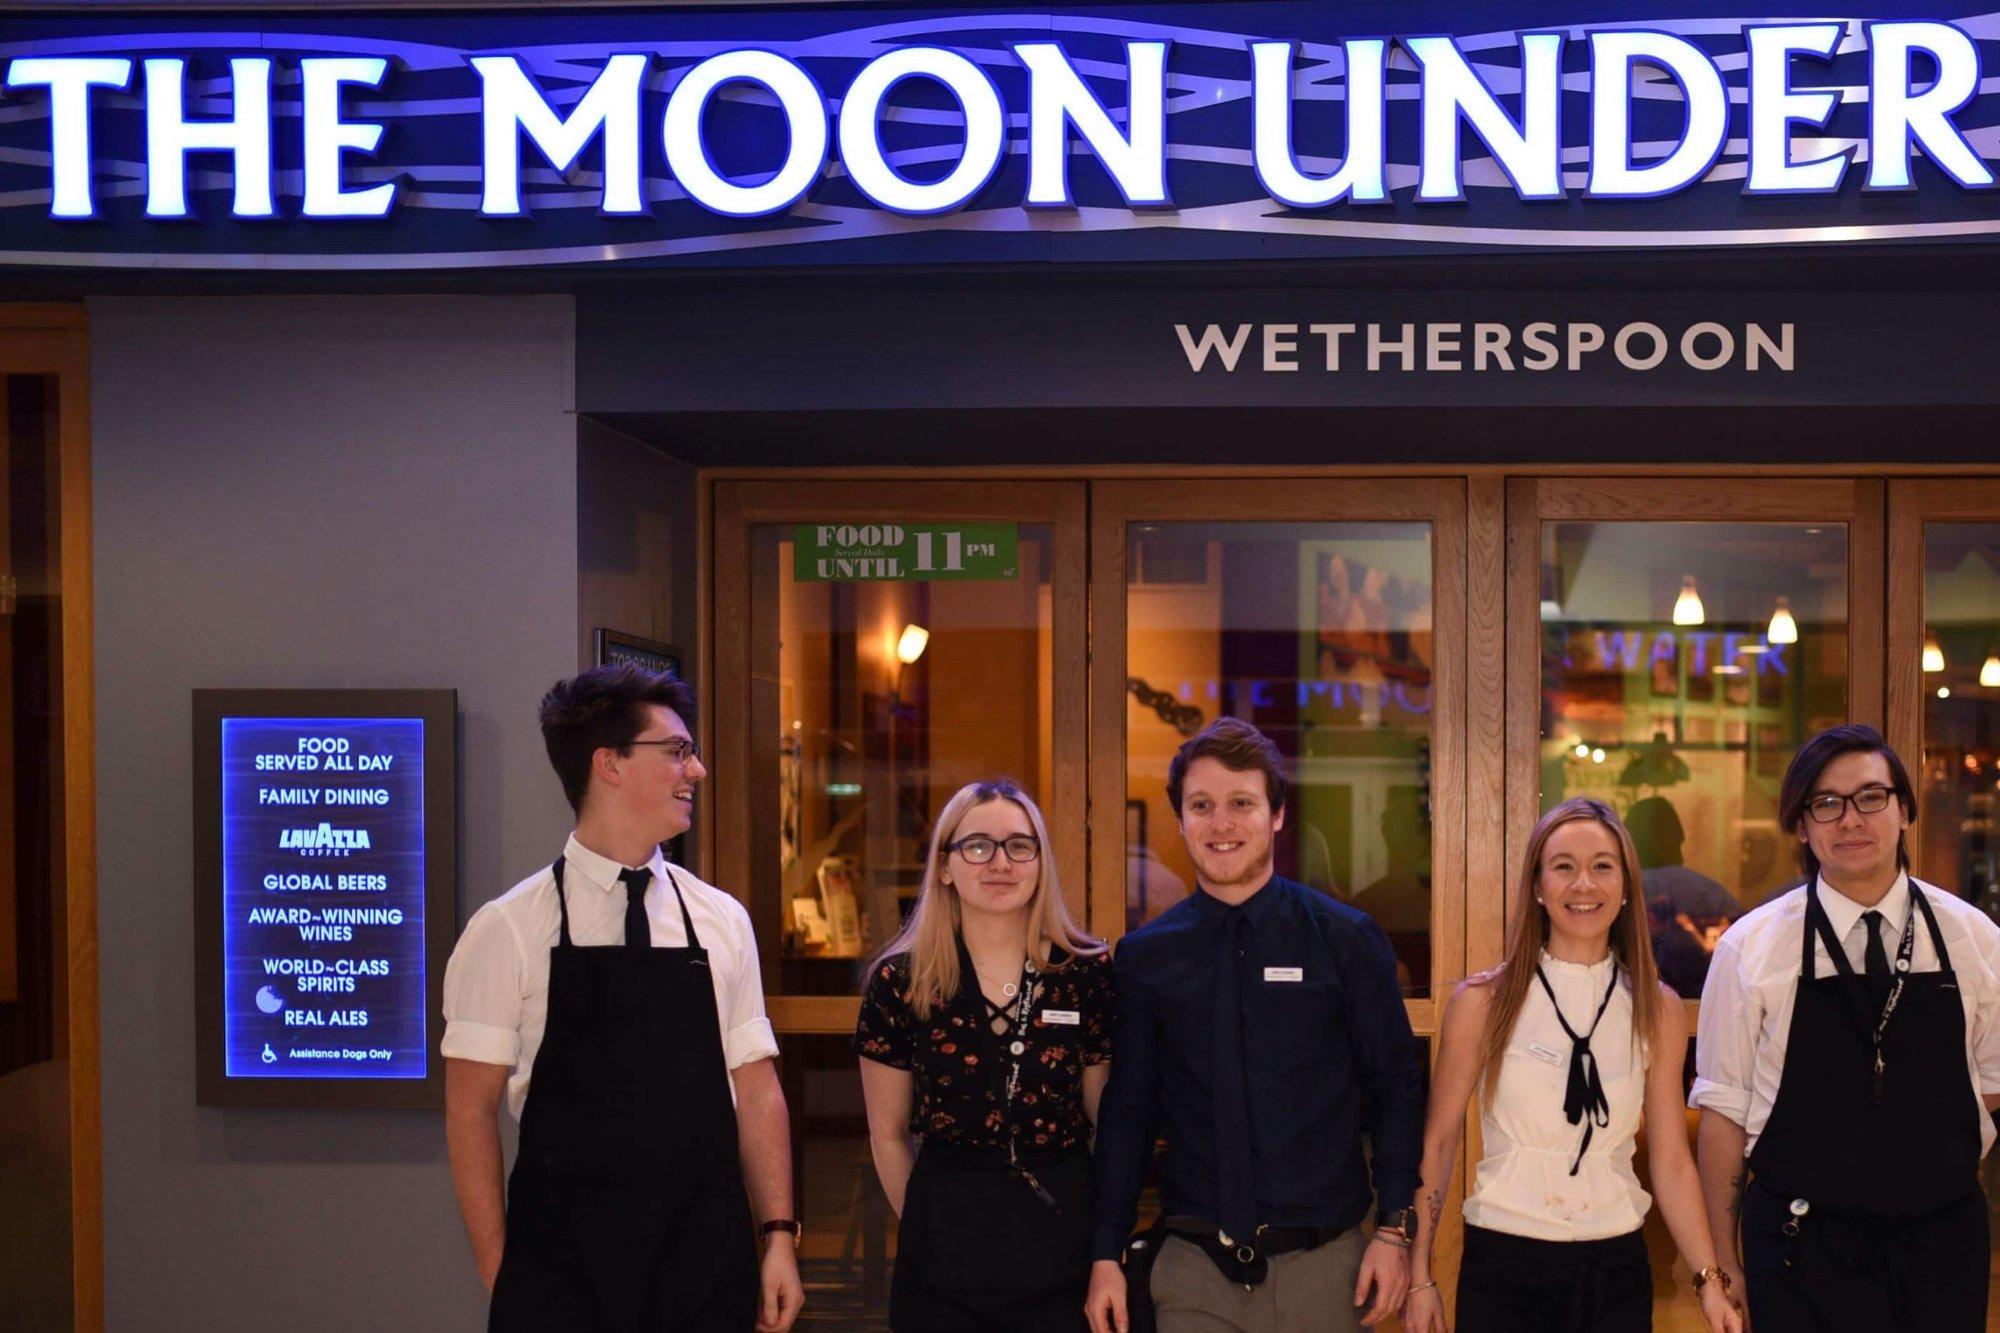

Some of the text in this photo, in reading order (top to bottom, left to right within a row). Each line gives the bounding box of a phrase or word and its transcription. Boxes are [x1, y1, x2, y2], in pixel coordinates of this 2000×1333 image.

[8, 19, 1994, 217] THE MOON UNDER
[1174, 322, 1794, 372] WETHERSPOON
[816, 525, 904, 547] FOOD
[913, 531, 995, 571] 11 PM
[817, 558, 905, 578] UNTIL
[298, 737, 350, 754] FOOD
[255, 754, 394, 771] SERVED ALL DAY
[259, 788, 390, 805] FAMILY DINING
[279, 822, 371, 849] LAVAZZA
[300, 849, 350, 857] COFFEE
[263, 874, 387, 891] GLOBAL BEERS
[298, 925, 353, 942] WINES
[297, 975, 356, 993] SPIRITS
[284, 1010, 369, 1027] REAL ALES
[289, 1048, 393, 1061] Assistance Dogs Only
